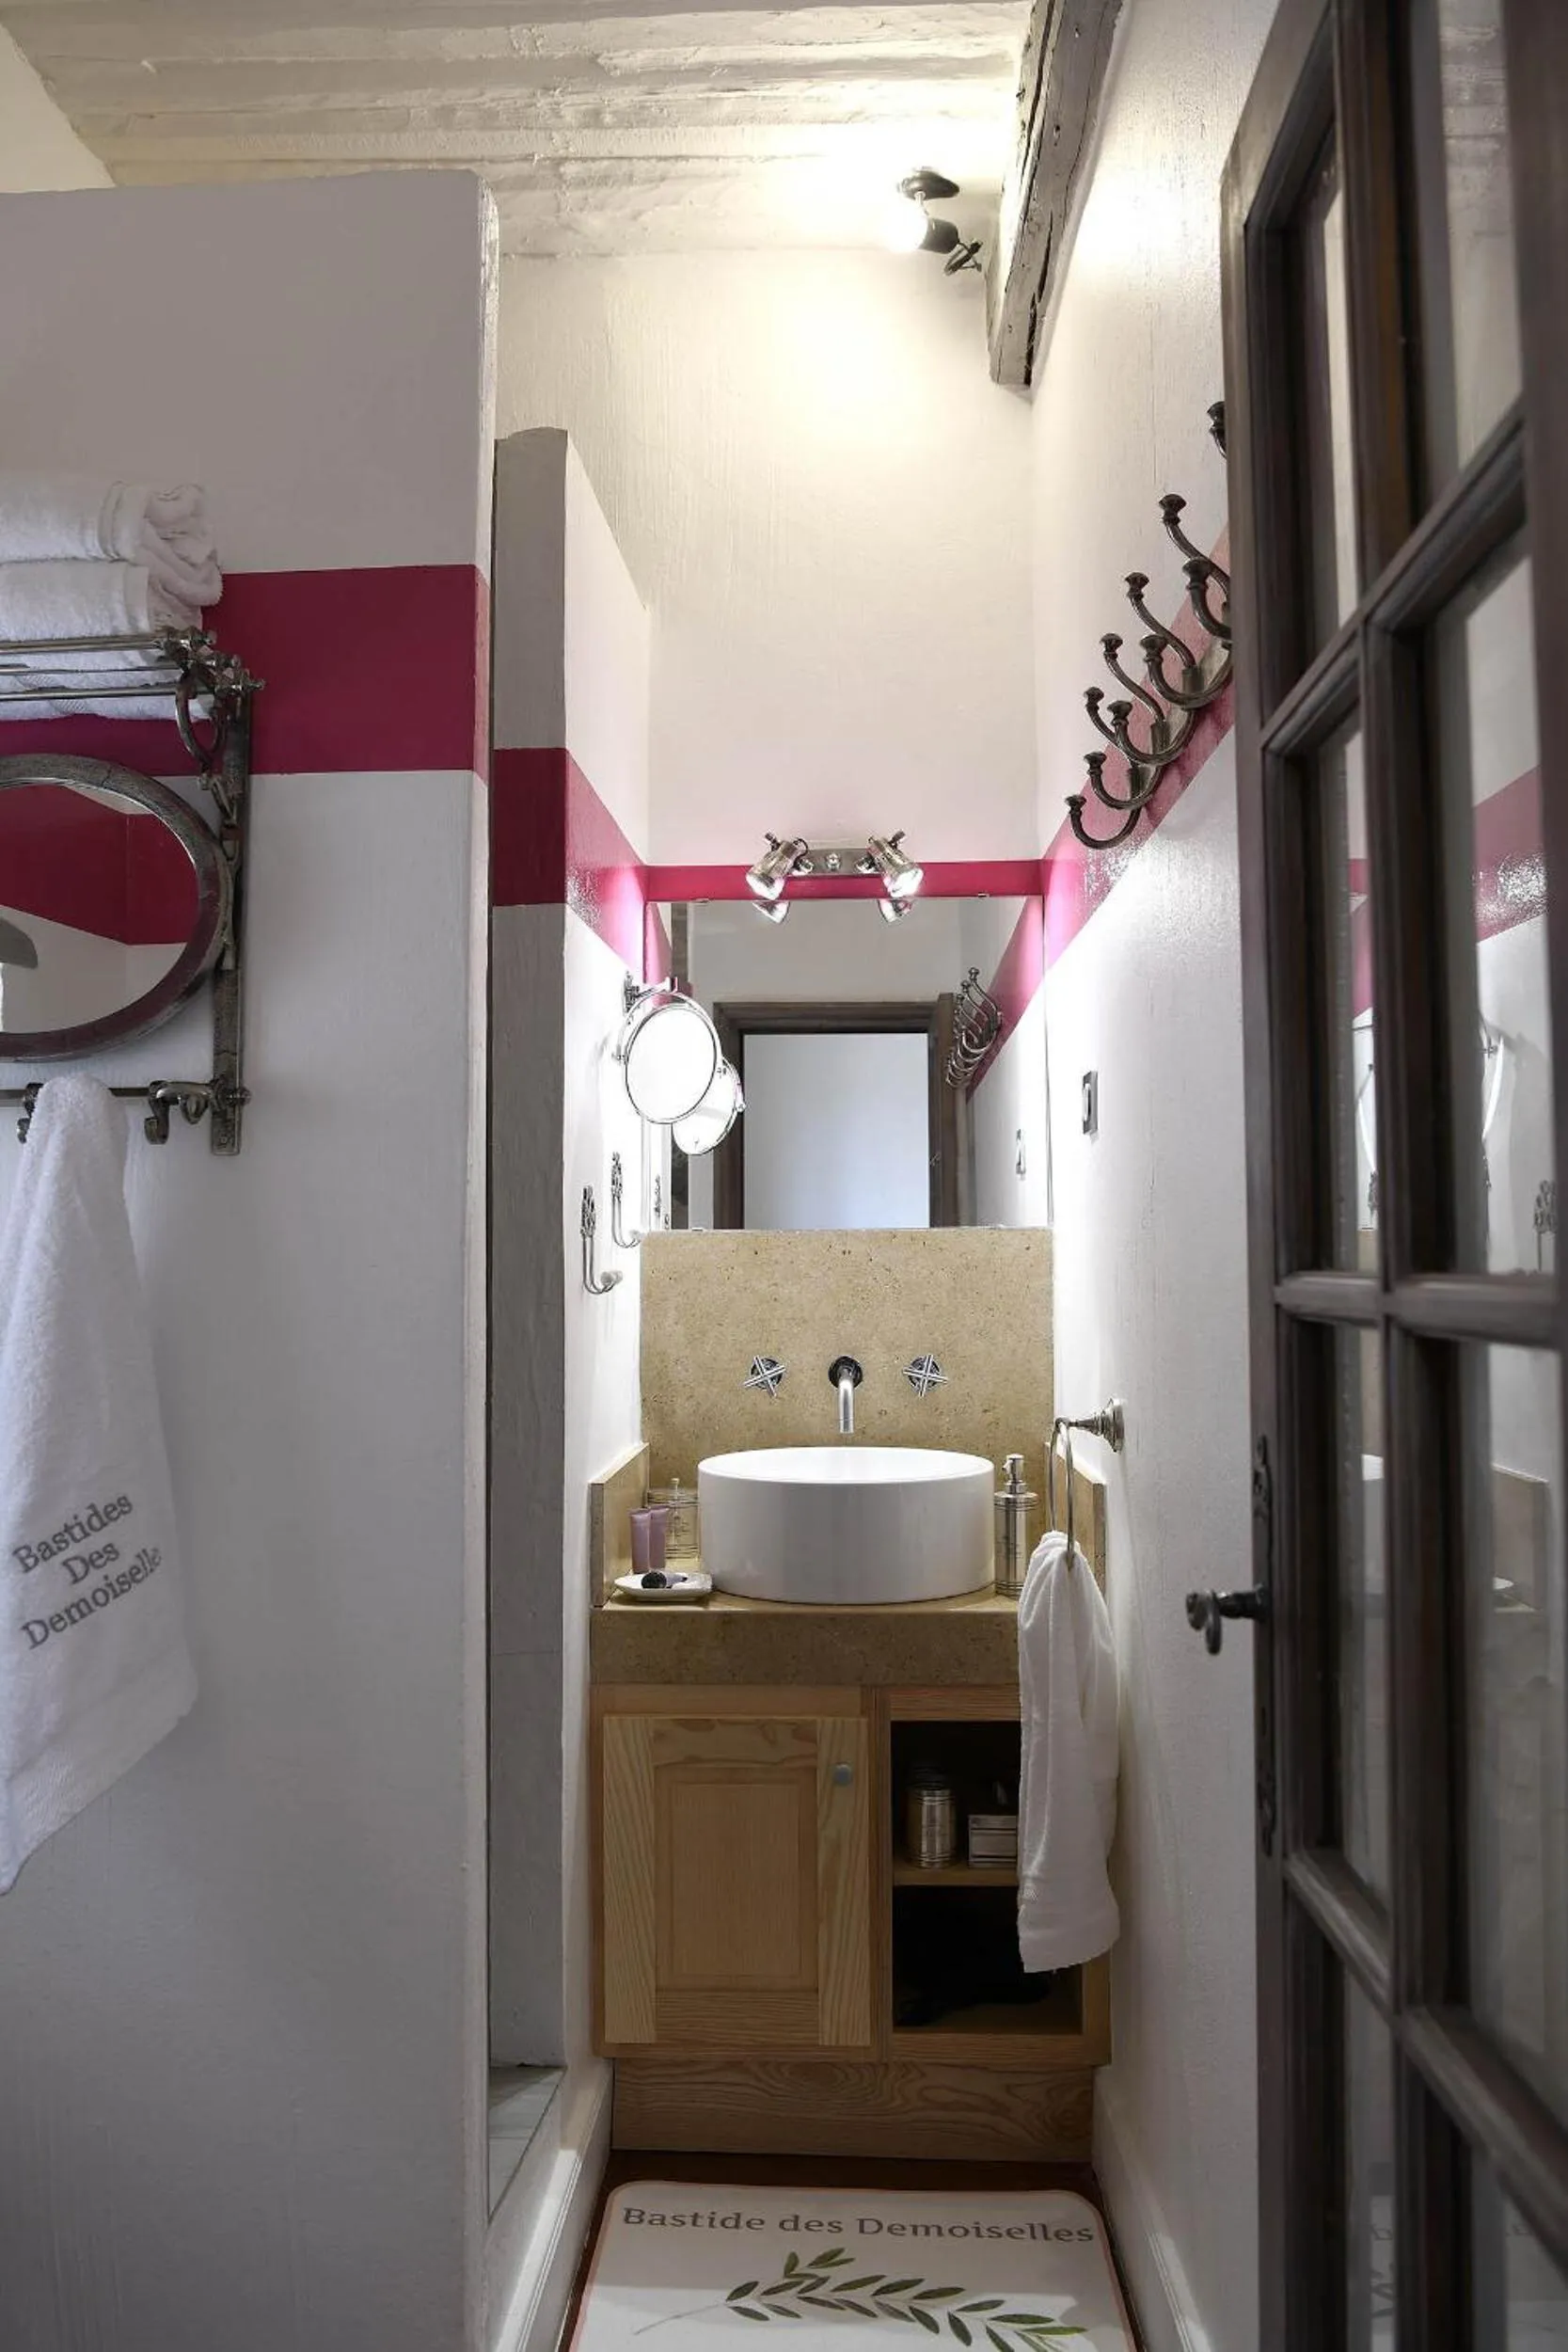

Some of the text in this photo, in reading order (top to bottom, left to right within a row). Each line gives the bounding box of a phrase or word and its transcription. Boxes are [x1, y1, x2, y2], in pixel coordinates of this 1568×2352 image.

[12, 1495, 134, 1574] Bastides
[61, 1542, 120, 1585] Des
[623, 2207, 1094, 2242] Bastide des Demoiselles
